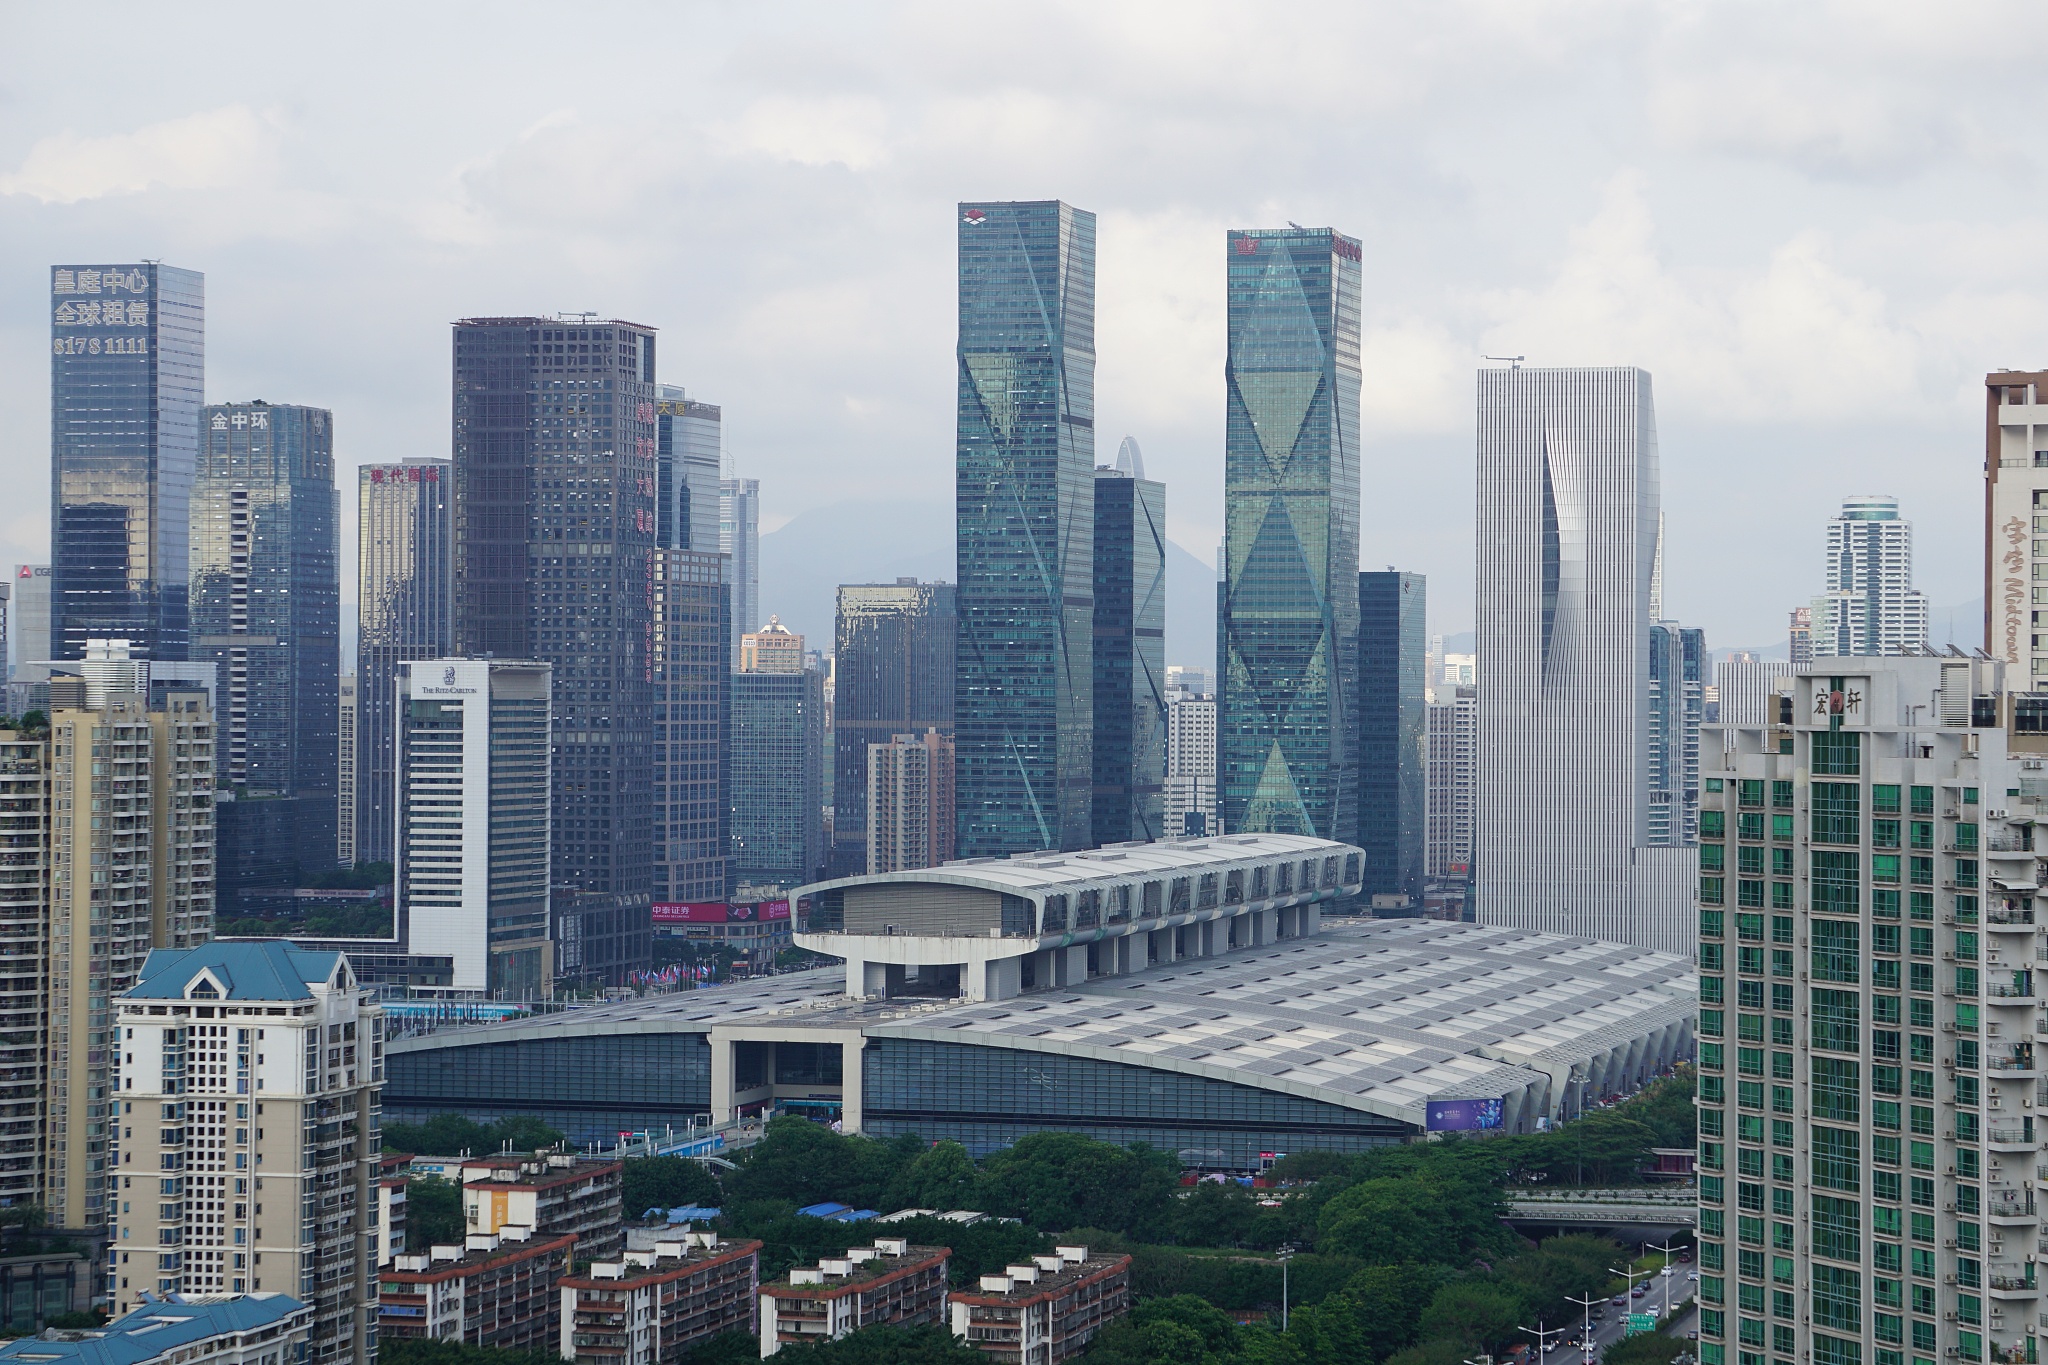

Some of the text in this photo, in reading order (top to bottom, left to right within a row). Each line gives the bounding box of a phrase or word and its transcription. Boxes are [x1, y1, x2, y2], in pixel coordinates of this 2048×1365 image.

[53, 267, 149, 295] 皇庭中心
[53, 301, 149, 327] 全球租赁
[53, 337, 148, 355] 8178 1111
[657, 401, 686, 416] 大厦
[210, 411, 268, 430] 金中环
[370, 468, 439, 484] 现代国际
[422, 686, 434, 694] THE
[1813, 687, 1863, 716] 宏轩
[652, 905, 690, 915] 中泰证券
